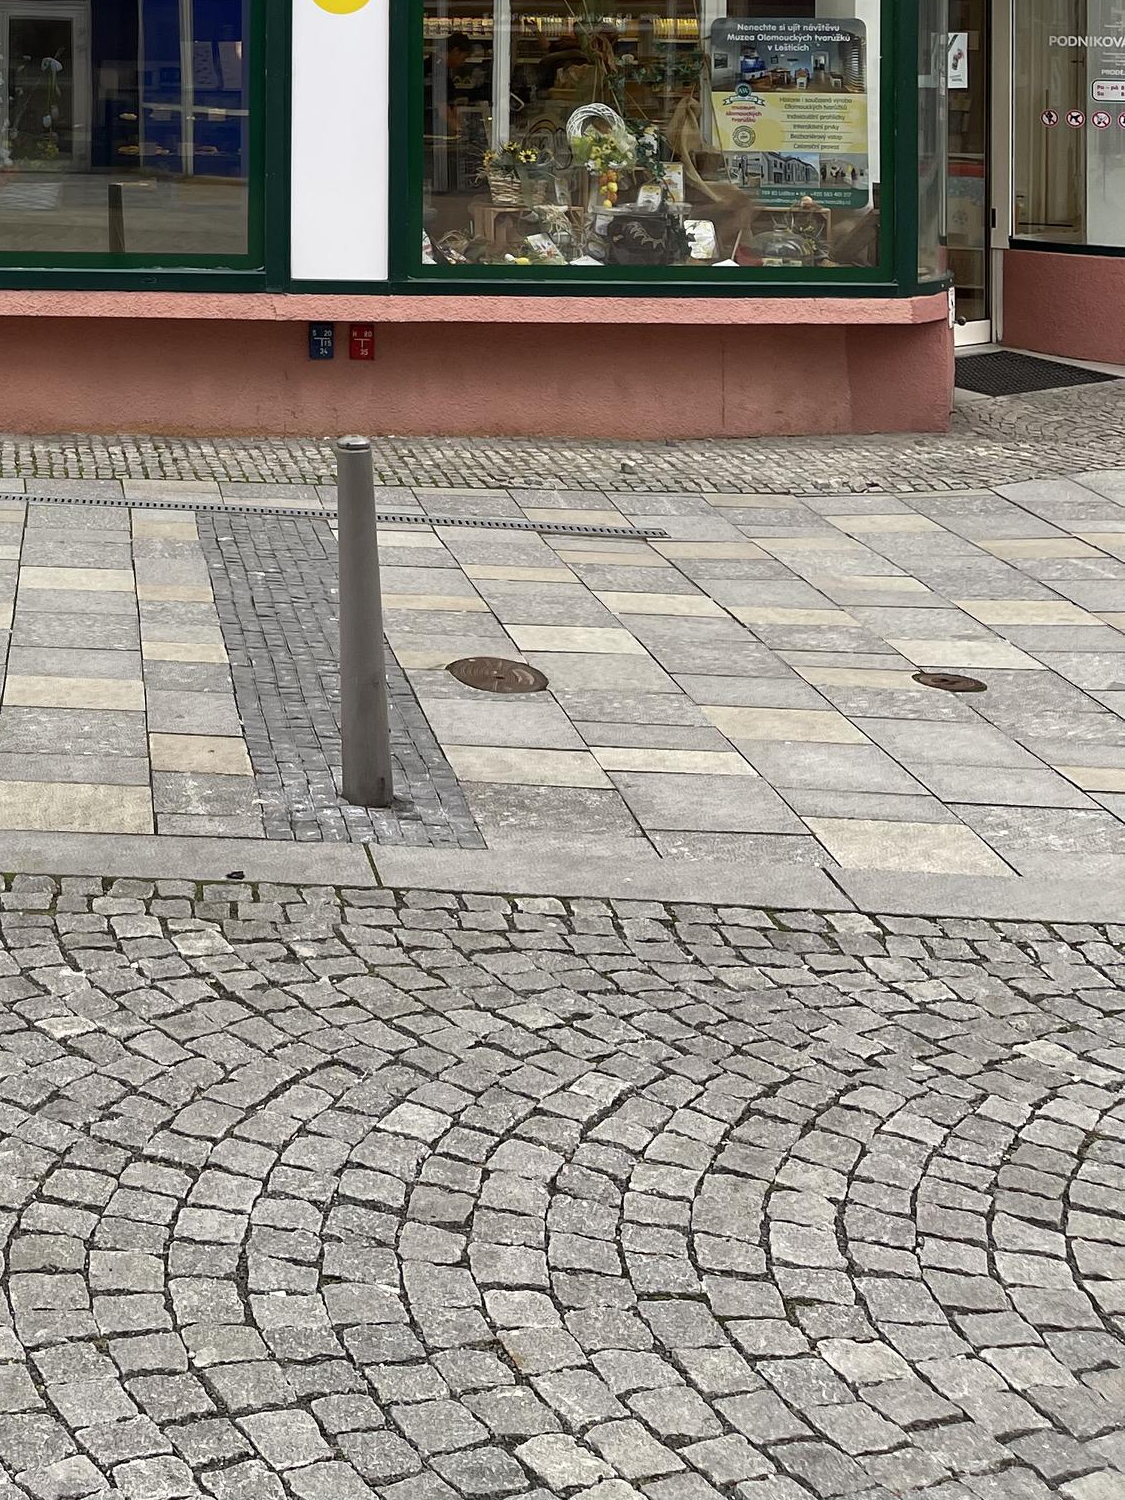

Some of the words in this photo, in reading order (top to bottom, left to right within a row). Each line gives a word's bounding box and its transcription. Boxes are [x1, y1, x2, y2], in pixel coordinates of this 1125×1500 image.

[737, 23, 777, 31] Nenechte
[779, 23, 786, 31] si
[803, 23, 840, 32] návštěvu
[727, 33, 755, 42] Muzea
[757, 33, 813, 44] Olomouckých
